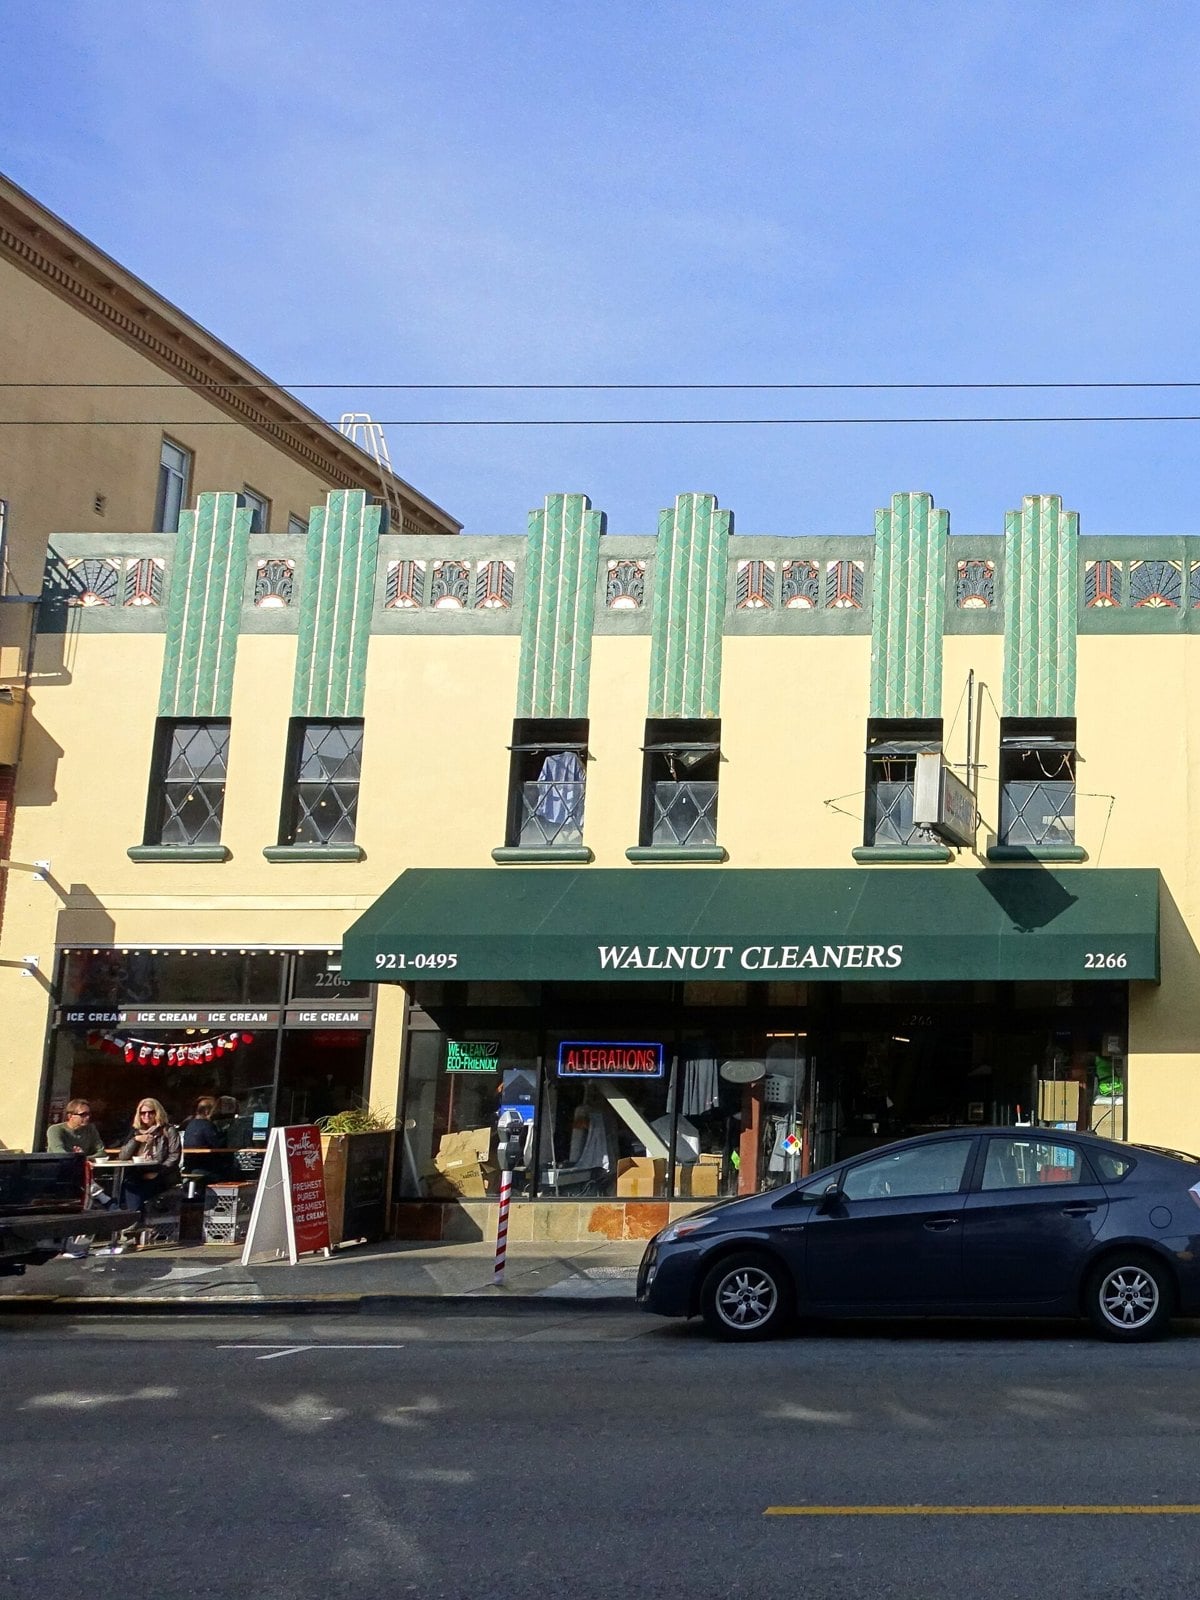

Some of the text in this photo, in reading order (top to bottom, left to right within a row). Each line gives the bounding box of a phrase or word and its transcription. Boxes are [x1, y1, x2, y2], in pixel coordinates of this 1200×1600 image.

[375, 953, 458, 969] 921-0495
[598, 944, 903, 970] WALNUT CLEANERS
[1084, 953, 1127, 968] 2266
[66, 1013, 127, 1021] ICE CREAM
[137, 1013, 197, 1021] ICE CREAM
[207, 1013, 268, 1021] ICE CREAM
[299, 1013, 359, 1021] ICE CREAM
[448, 1043, 486, 1057] WE CLEAN
[447, 1056, 498, 1069] ECO-FRIENDLY
[567, 1050, 655, 1071] ALTERATIONS
[292, 1179, 322, 1191] FRESHEST
[297, 1190, 319, 1201] PUREST
[293, 1200, 326, 1213] CREAMIEST
[296, 1210, 324, 1222] ICE CREAM
